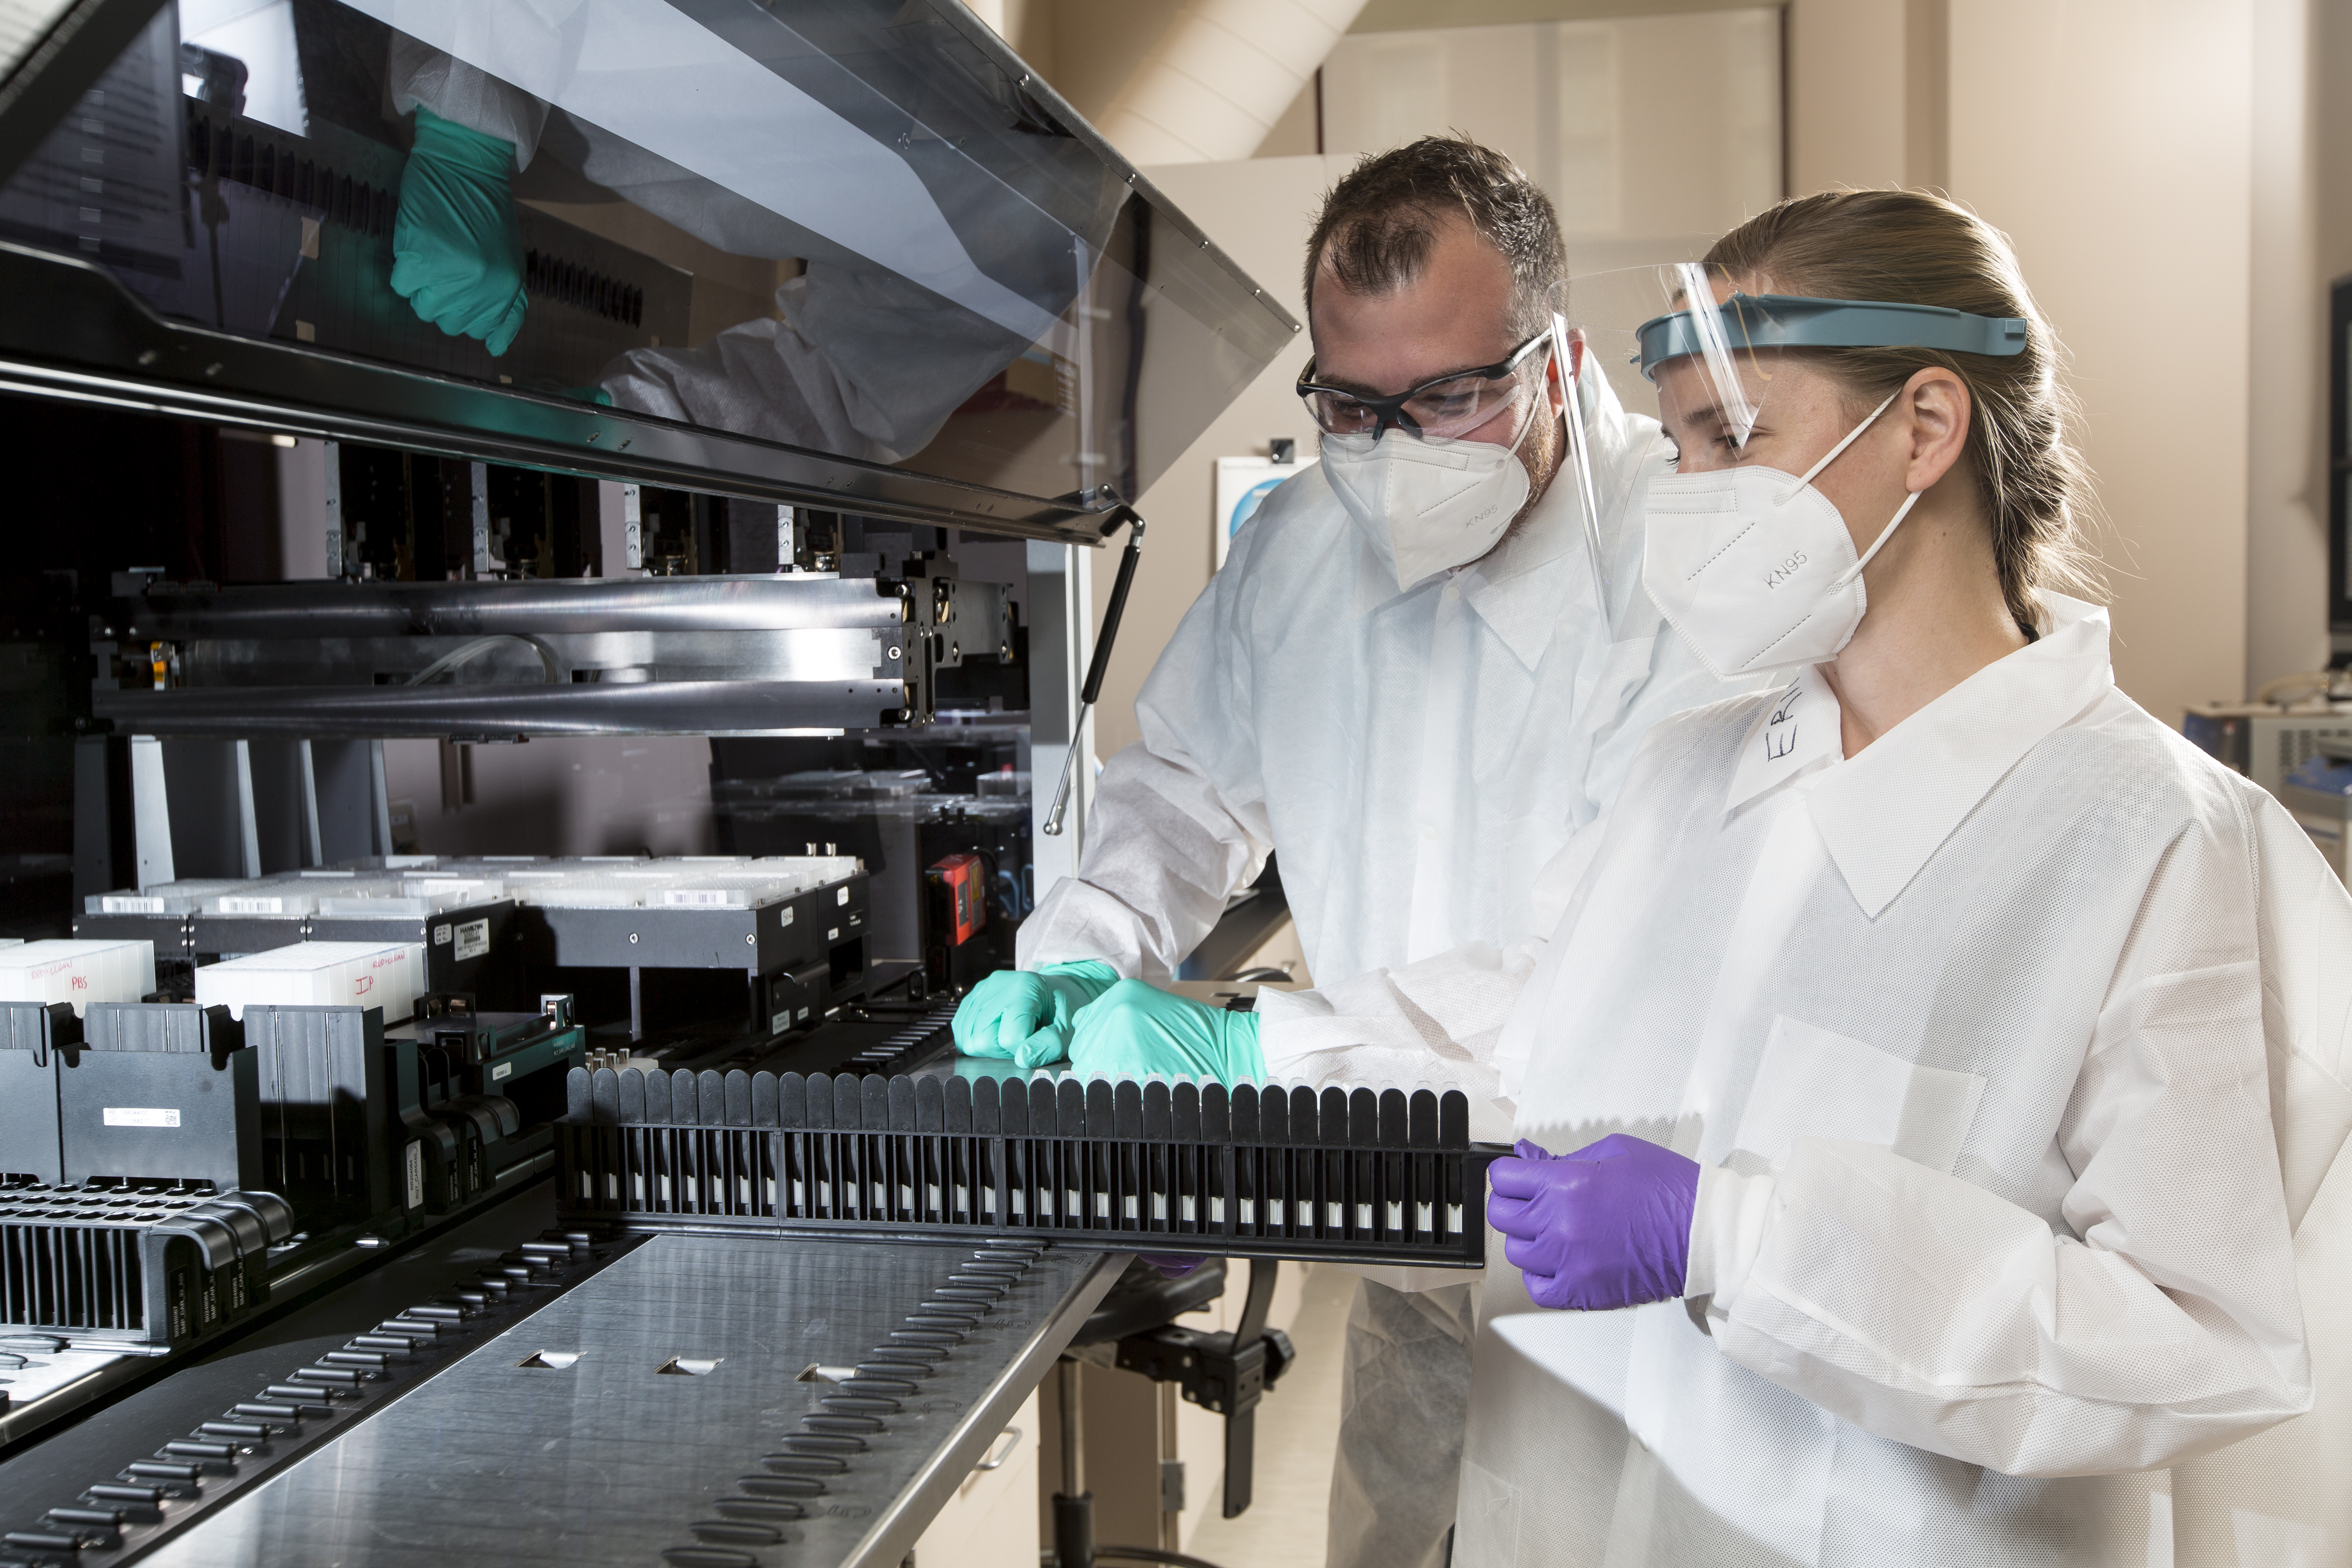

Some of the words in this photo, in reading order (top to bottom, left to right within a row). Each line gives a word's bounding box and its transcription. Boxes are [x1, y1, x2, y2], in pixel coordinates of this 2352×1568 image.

[1466, 504, 1498, 528] KN95
[1764, 551, 1807, 589] KN95
[460, 922, 483, 935] HAMILTON
[72, 976, 87, 991] PBS
[356, 976, 373, 995] IP
[1051, 1253, 1087, 1265] 20
[993, 1319, 1031, 1331] 15
[827, 1504, 872, 1518] 5
